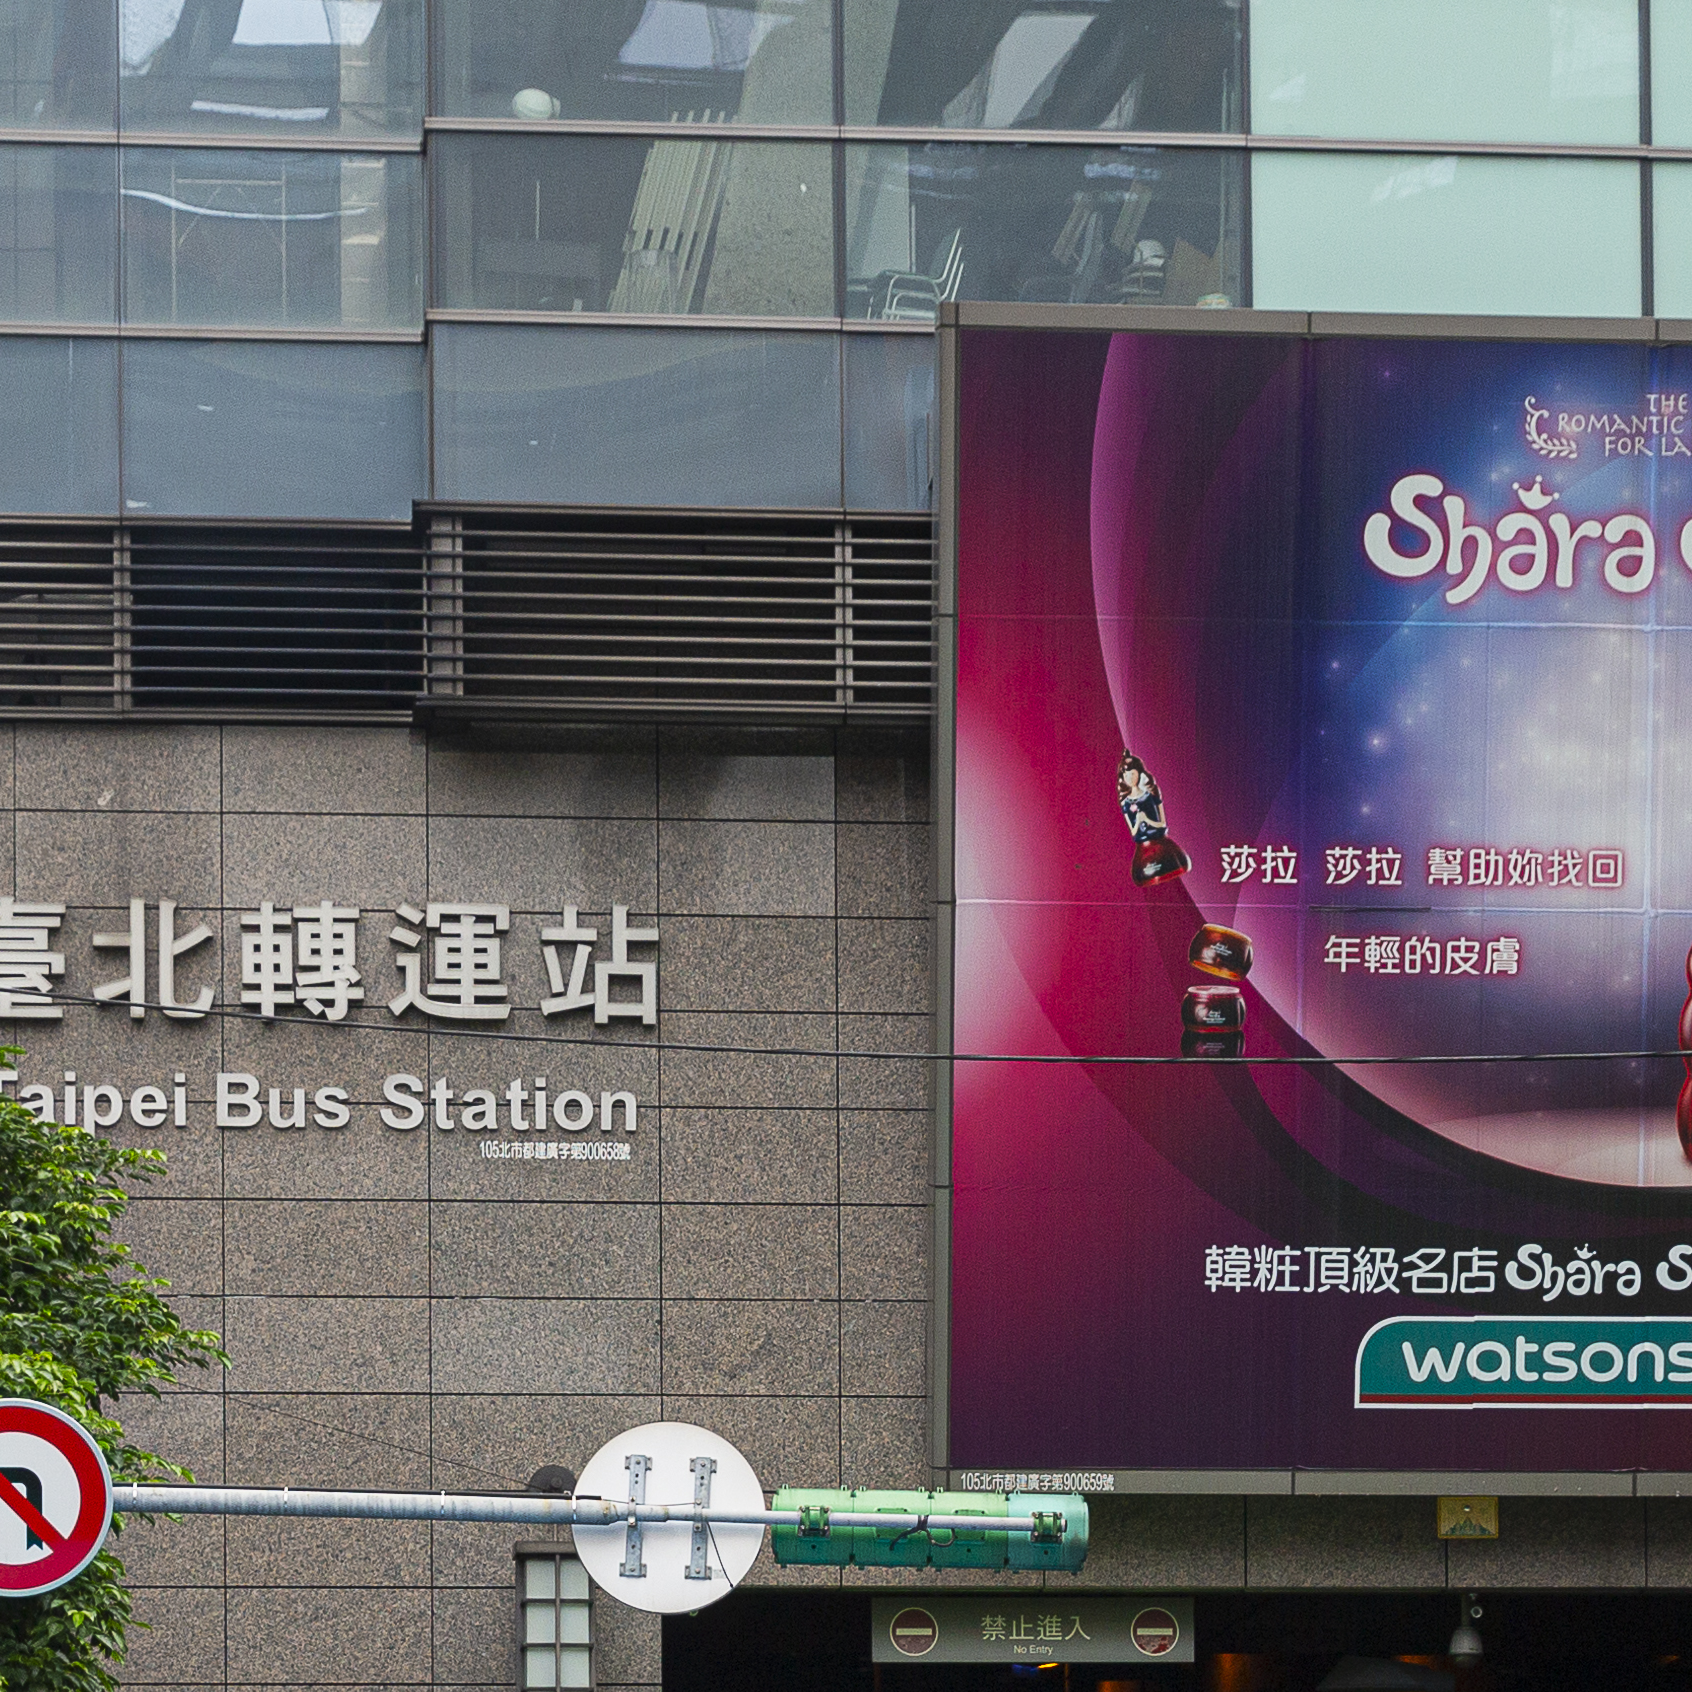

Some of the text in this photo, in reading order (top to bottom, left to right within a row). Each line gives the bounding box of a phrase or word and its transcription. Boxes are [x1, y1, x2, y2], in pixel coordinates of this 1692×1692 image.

[1646, 393, 1688, 414] THE
[1557, 413, 1687, 437] ROMANTIC
[1604, 436, 1654, 457] FOR
[1363, 474, 1655, 606] Shara
[1219, 843, 1626, 890] 莎拉 莎拉 幫助妳找回
[1323, 933, 1522, 978] 年輕的皮膚
[215, 1071, 352, 1129] Bus
[379, 1072, 639, 1133] Station
[479, 1140, 631, 1160] 105北市都建廣字第900658號
[1204, 1246, 1497, 1297] 韓粧頂級名店
[1504, 1243, 1642, 1304] Shara
[960, 1472, 1115, 1491] 105北市都建廣字第900659號
[981, 1614, 1091, 1642] 禁止進入
[1013, 1644, 1053, 1656] No Entry
